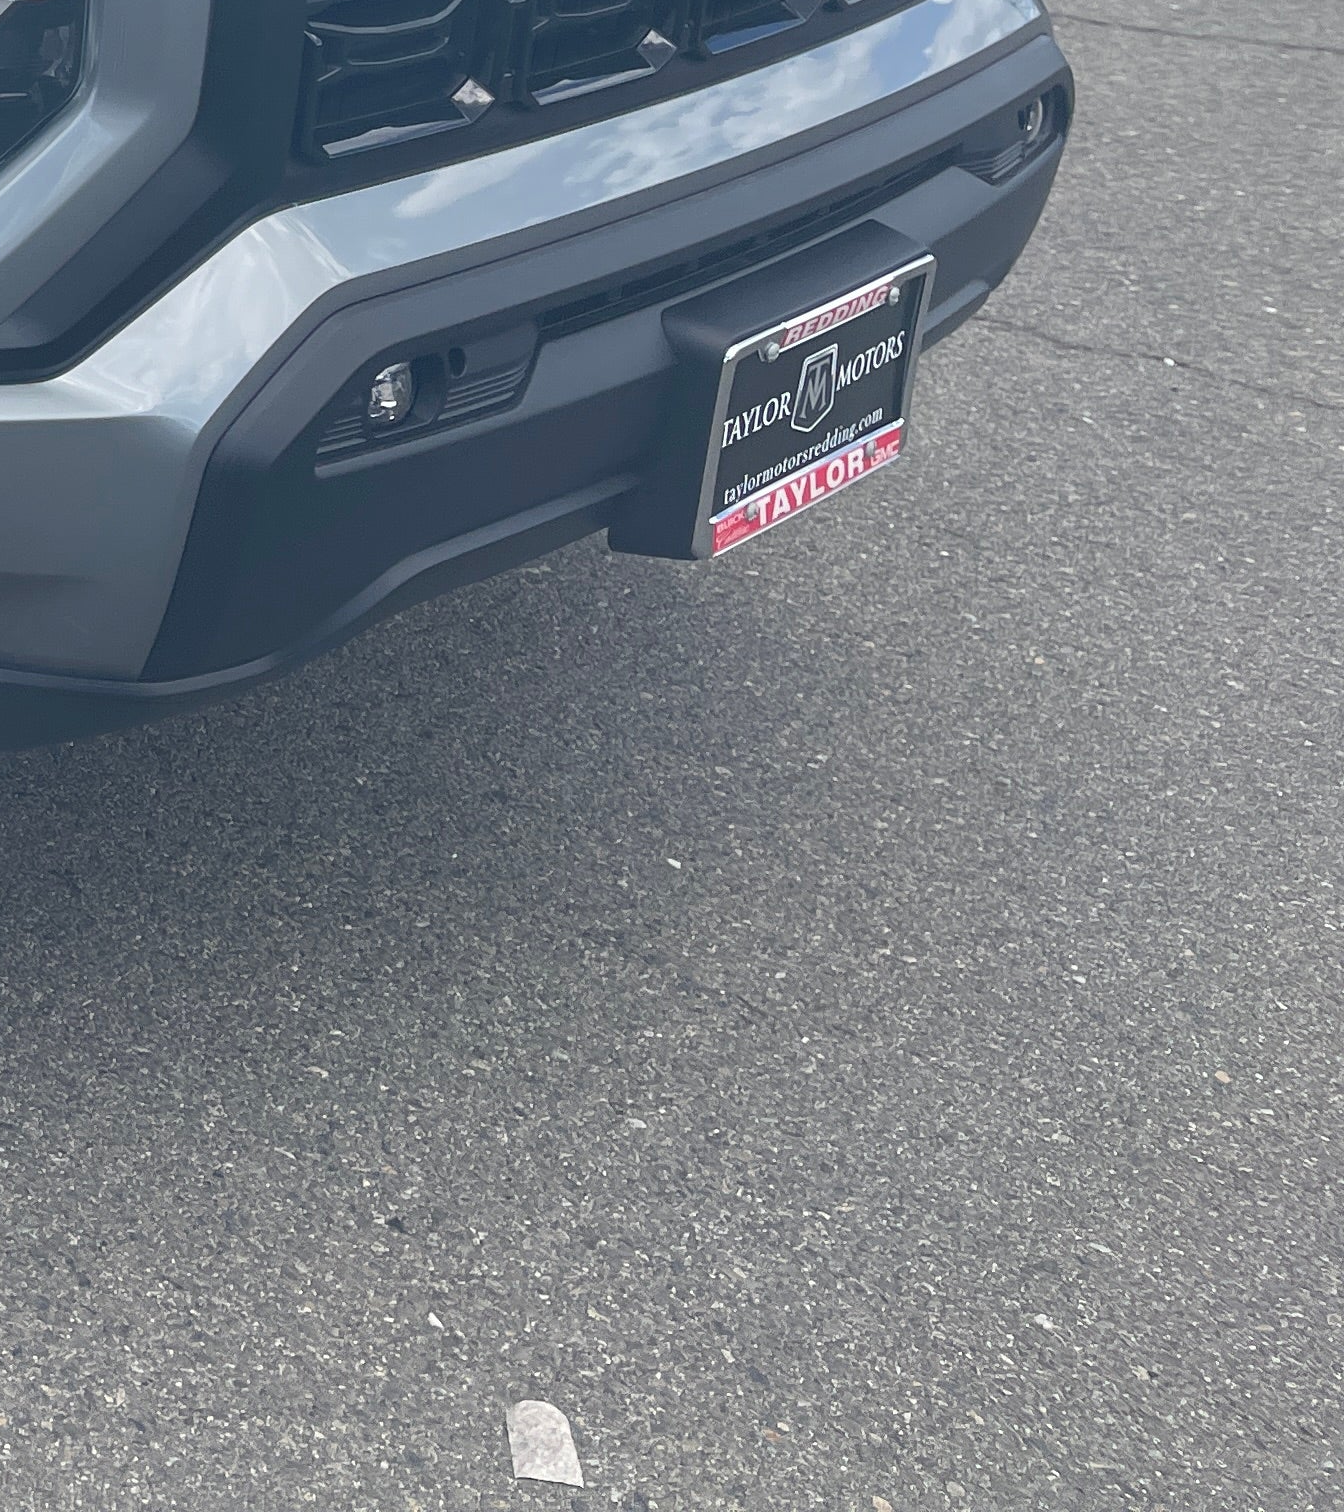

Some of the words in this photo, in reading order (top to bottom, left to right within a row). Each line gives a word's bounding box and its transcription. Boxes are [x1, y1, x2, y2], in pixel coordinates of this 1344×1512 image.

[783, 285, 890, 346] REDDING
[721, 391, 792, 448] TAYLOR
[836, 330, 905, 392] MOTORS
[724, 407, 883, 505] taylormotorsredding.com
[756, 447, 865, 527] TAYLOR
[870, 440, 900, 466] GMC
